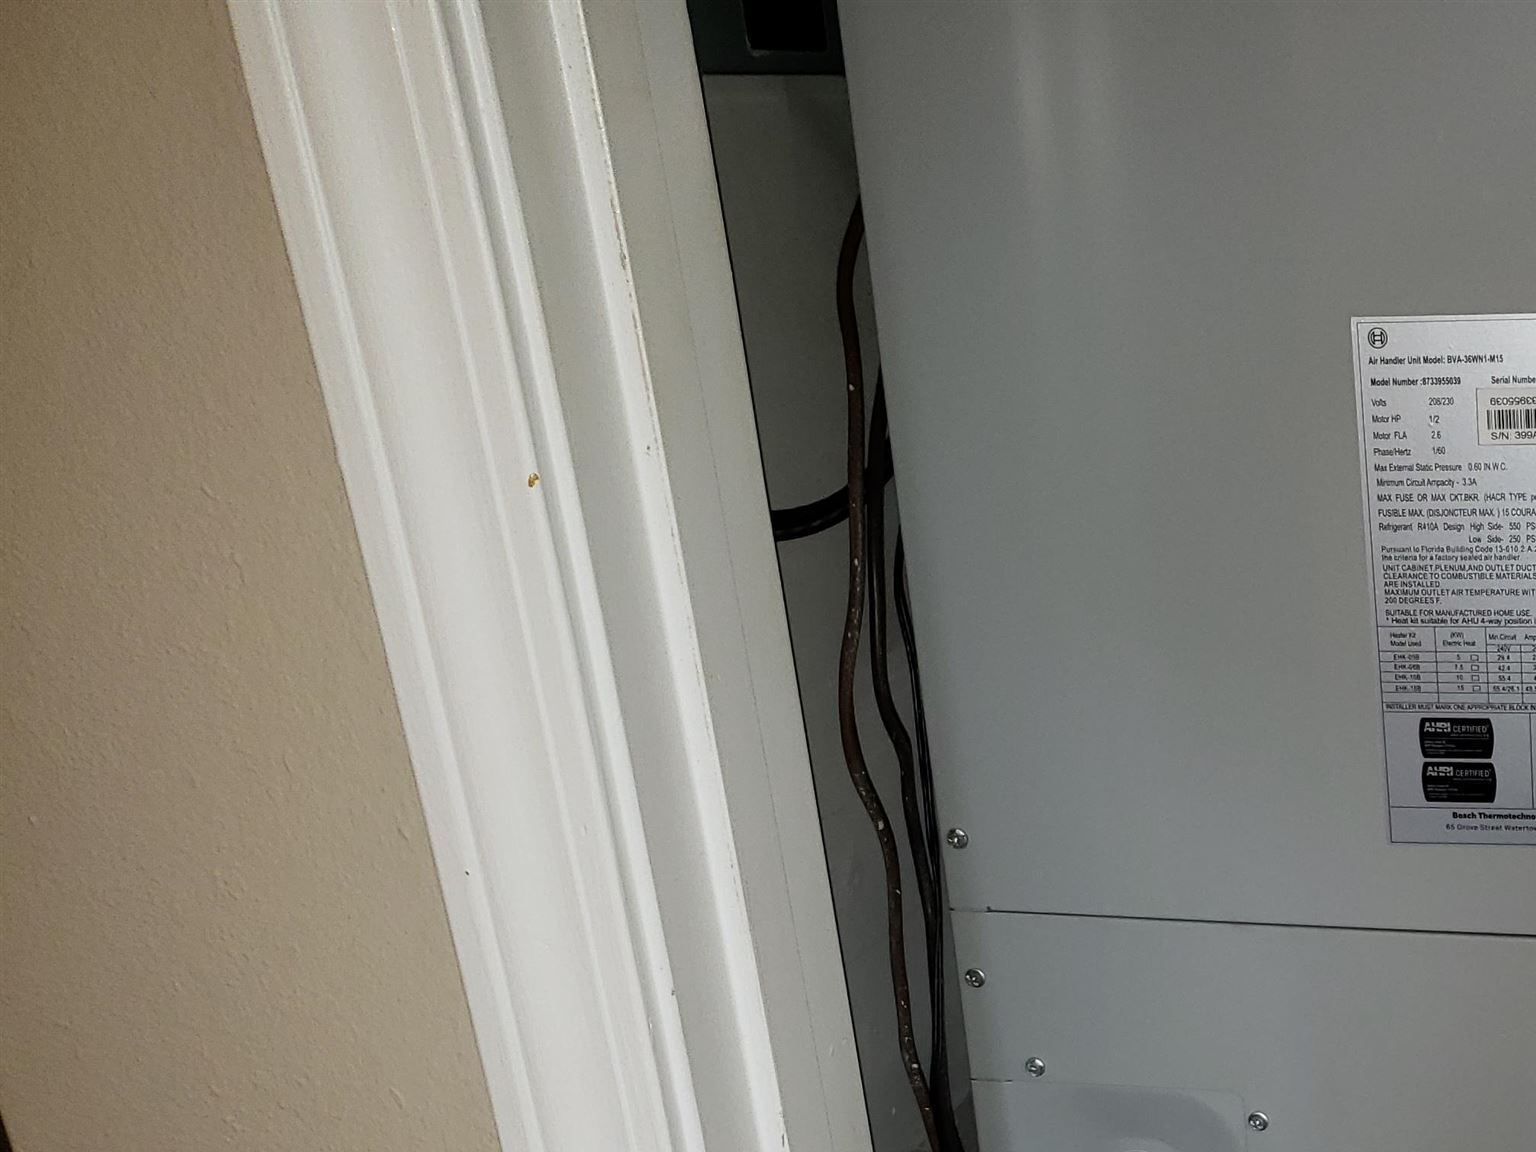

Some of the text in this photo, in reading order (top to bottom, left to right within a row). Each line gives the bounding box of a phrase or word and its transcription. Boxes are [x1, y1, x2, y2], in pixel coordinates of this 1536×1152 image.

[1368, 356, 1378, 364] Air
[1380, 356, 1406, 364] Handler
[1407, 356, 1421, 364] Unit
[1423, 355, 1446, 363] Model:
[1371, 378, 1391, 386] Model
[1392, 378, 1418, 386] Number
[1490, 376, 1511, 384] Serial
[1371, 399, 1387, 407] Volts
[1372, 414, 1440, 424] Motor HP 1/2
[1373, 431, 1391, 440] Motor
[1394, 431, 1407, 440] FLA
[1373, 446, 1446, 456] Phase/Hertz 1/60
[1374, 463, 1387, 471] Max
[1390, 463, 1414, 471] External
[1416, 463, 1433, 471] Static
[1434, 463, 1462, 471] Pressure
[1376, 480, 1404, 488] Minimum
[1406, 479, 1425, 487] Circuit
[1426, 479, 1455, 489] Ampacity
[1377, 493, 1392, 502] MAX
[1395, 493, 1414, 502] FUSE
[1417, 493, 1428, 502] OR
[1431, 493, 1447, 502] MAX
[1509, 492, 1527, 501] TYPE
[1378, 509, 1407, 518] FUSIBLE
[1426, 508, 1478, 519] (DISJONCTEUR
[1502, 508, 1510, 517] 15
[1379, 522, 1413, 532] Refrigerant
[1417, 522, 1440, 531] R410A
[1443, 522, 1465, 532] Design
[1469, 522, 1485, 532] High
[1508, 522, 1521, 531] 550
[1468, 534, 1482, 543] Low
[1508, 534, 1521, 543] 250
[1383, 572, 1428, 580] CLEARANCE
[1430, 572, 1440, 580] TO
[1441, 572, 1494, 580] COMBUSTIBLE
[1481, 618, 1502, 626] 4-way
[1504, 617, 1532, 626] position
[1455, 769, 1490, 777] CERTIFIED
[1452, 812, 1477, 820] Bosch
